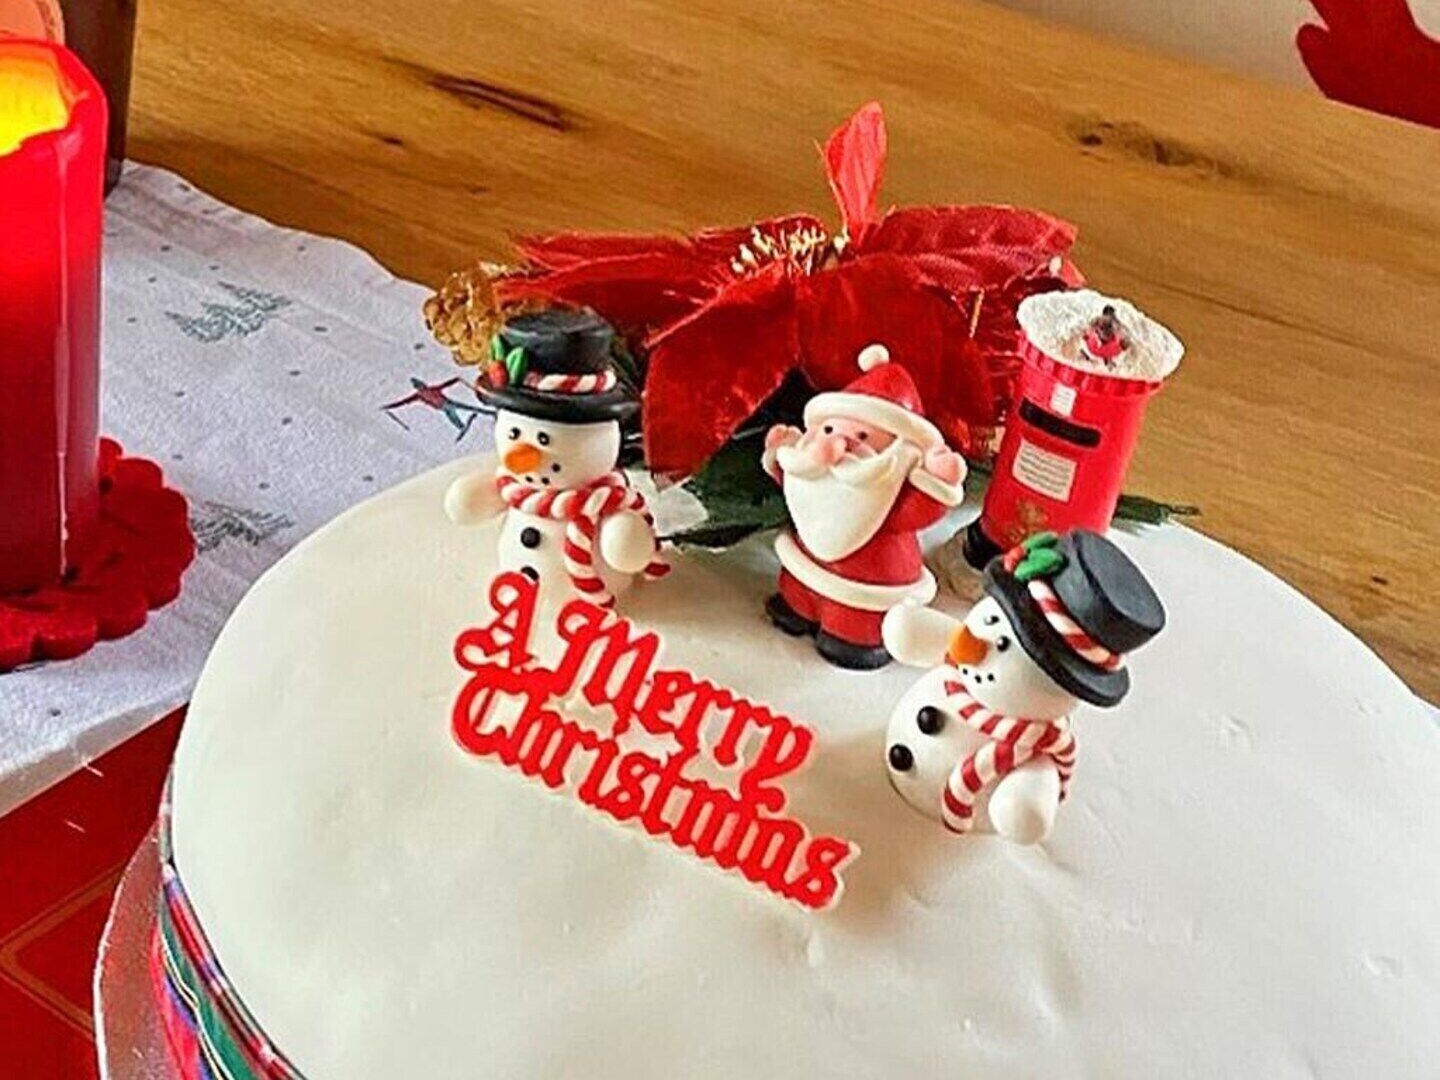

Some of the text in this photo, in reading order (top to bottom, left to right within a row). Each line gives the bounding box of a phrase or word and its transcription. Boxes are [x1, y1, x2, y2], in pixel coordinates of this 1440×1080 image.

[450, 667, 851, 910] Christmas
[453, 571, 813, 813] A Merry
